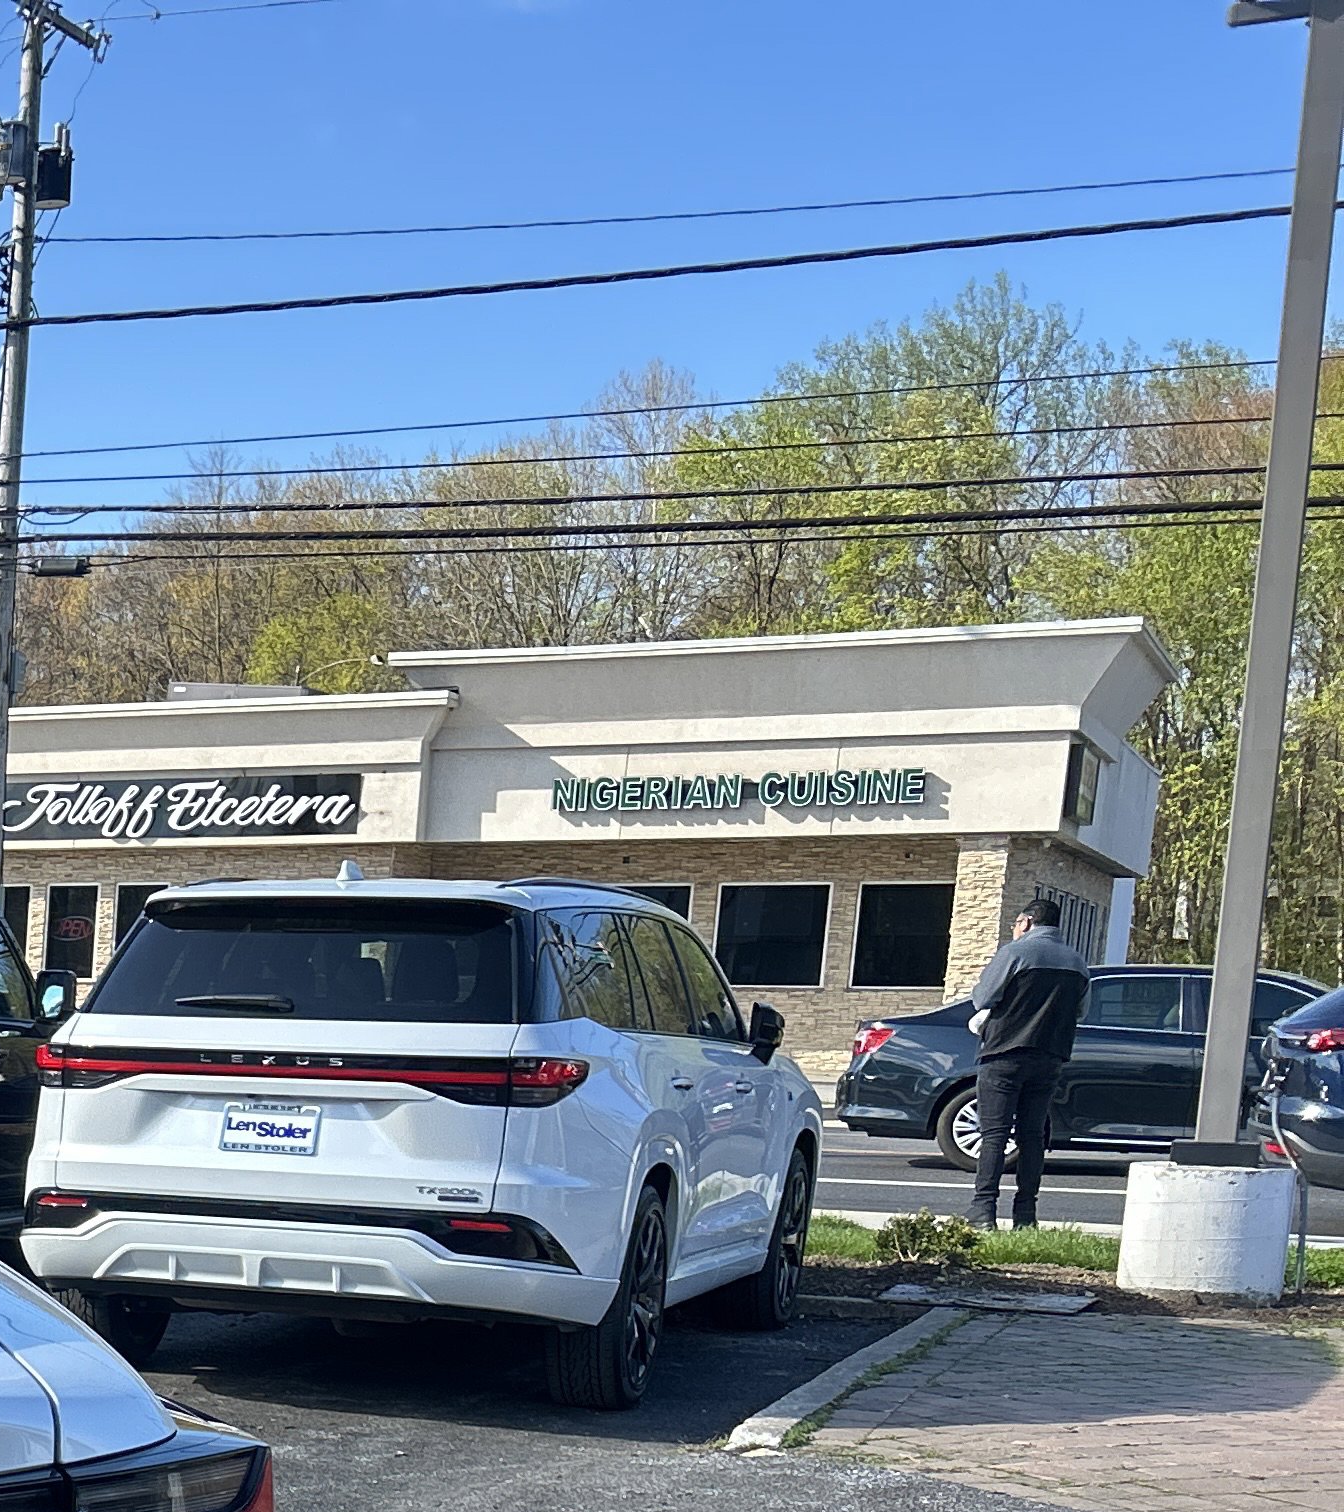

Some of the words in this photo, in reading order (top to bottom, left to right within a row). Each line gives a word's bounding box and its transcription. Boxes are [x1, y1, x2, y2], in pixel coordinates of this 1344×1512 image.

[551, 773, 742, 812] NIGERIAN
[757, 767, 926, 808] CUISINE
[166, 779, 356, 831] Etcetera
[200, 1053, 343, 1067] LEXUS
[223, 1142, 250, 1151] LEN
[254, 1143, 308, 1154] STOLER
